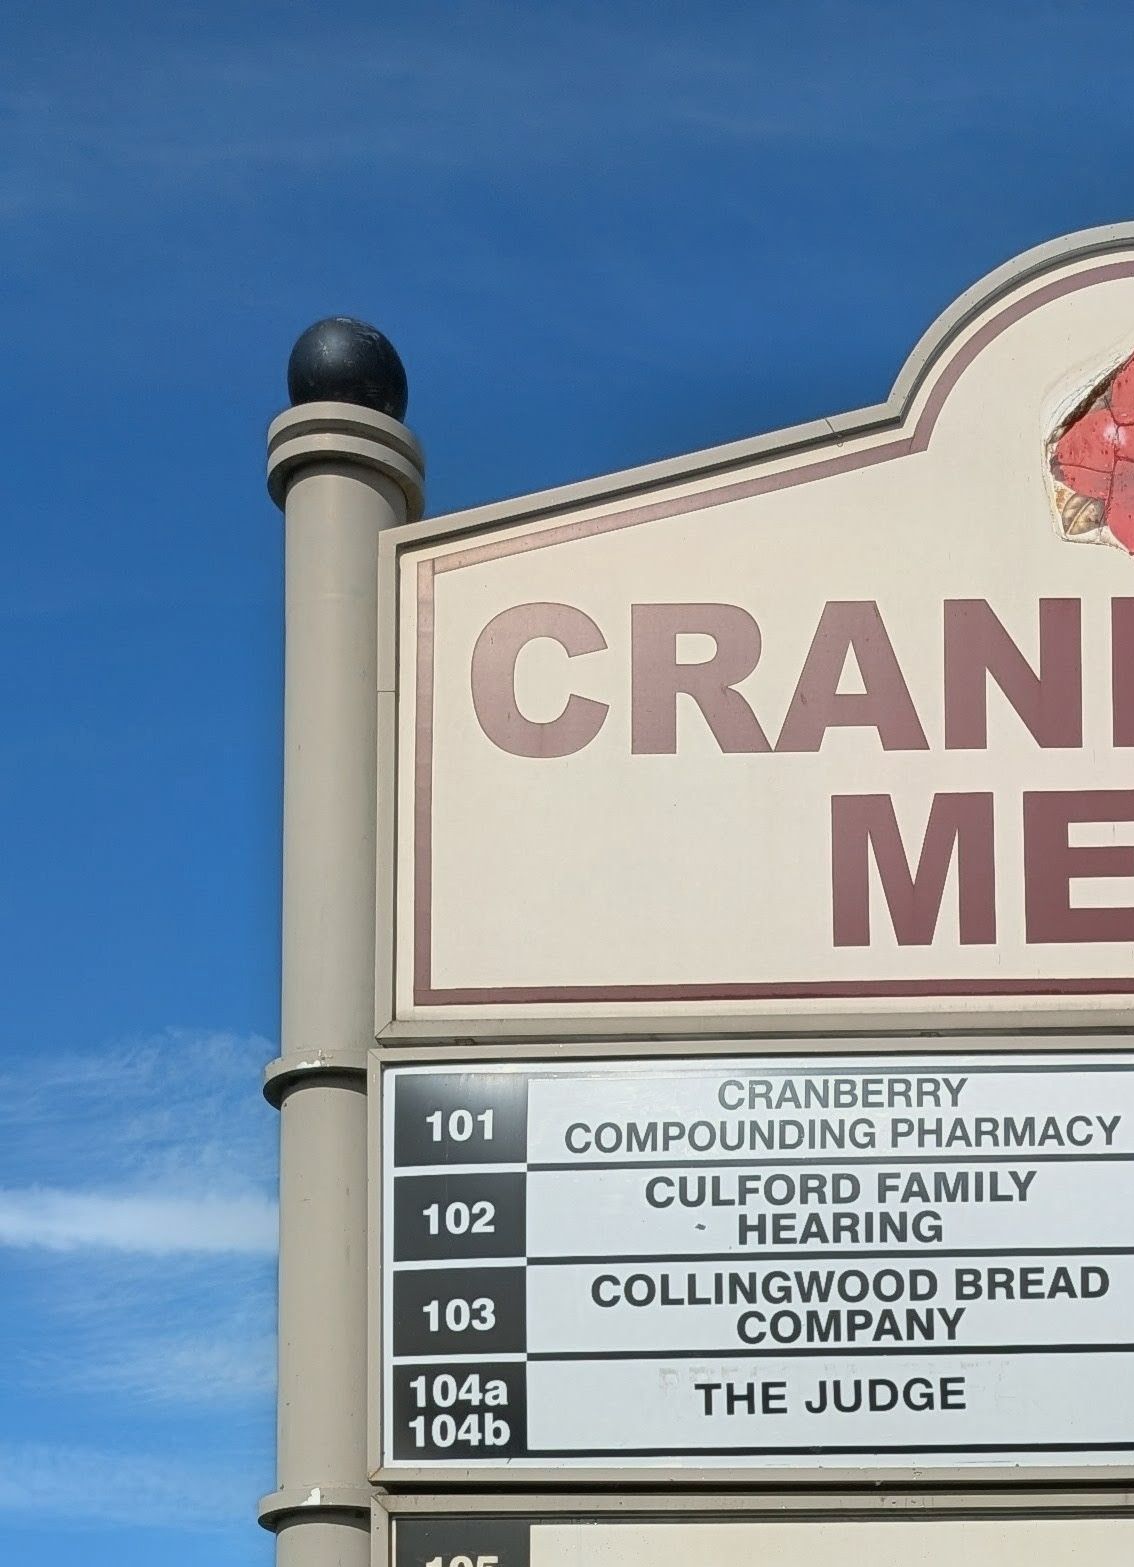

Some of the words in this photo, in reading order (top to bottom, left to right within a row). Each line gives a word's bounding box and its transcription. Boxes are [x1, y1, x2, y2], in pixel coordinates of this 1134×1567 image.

[718, 1078, 968, 1110] CRANBERRY
[426, 1109, 493, 1141] 101
[565, 1118, 875, 1153] COMPOUNDING
[892, 1116, 1121, 1148] PHARMACY
[646, 1173, 860, 1208] CULFORD
[878, 1171, 1037, 1203] FAMILY
[423, 1201, 495, 1234] 102
[739, 1210, 942, 1245] HEARING
[592, 1269, 937, 1307] COLLINGWOOD
[955, 1267, 1109, 1300] BREAD
[423, 1298, 495, 1331] 103
[737, 1308, 966, 1344] COMPANY
[410, 1374, 508, 1407] 104a
[695, 1382, 787, 1415] THE
[805, 1377, 966, 1413] JUDGE
[409, 1413, 510, 1447] 104b
